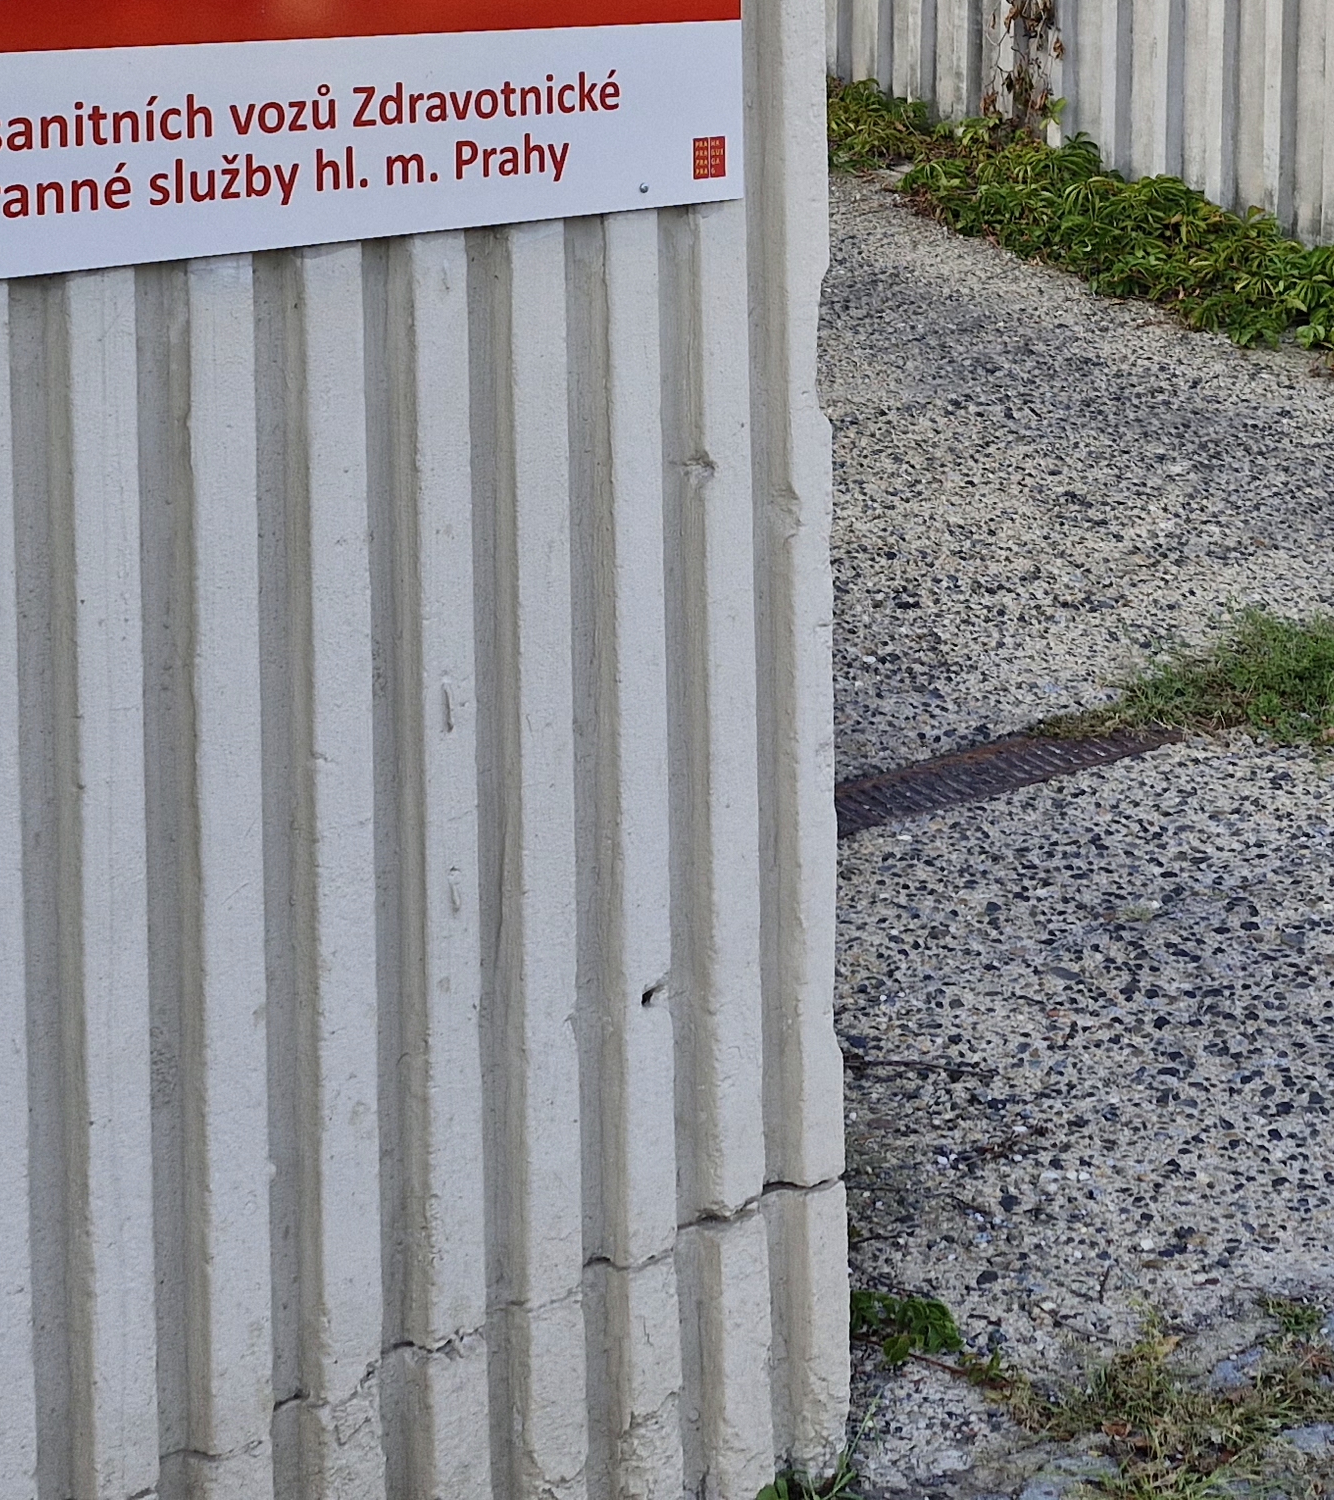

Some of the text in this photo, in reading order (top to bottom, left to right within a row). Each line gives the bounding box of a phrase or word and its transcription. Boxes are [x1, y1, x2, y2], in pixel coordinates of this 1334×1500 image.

[229, 83, 338, 136] vozů
[352, 69, 622, 129] Zdravotnické
[149, 153, 301, 206] služby
[315, 145, 370, 192] hl.
[386, 153, 440, 187] m.
[454, 133, 570, 182] Prahy
